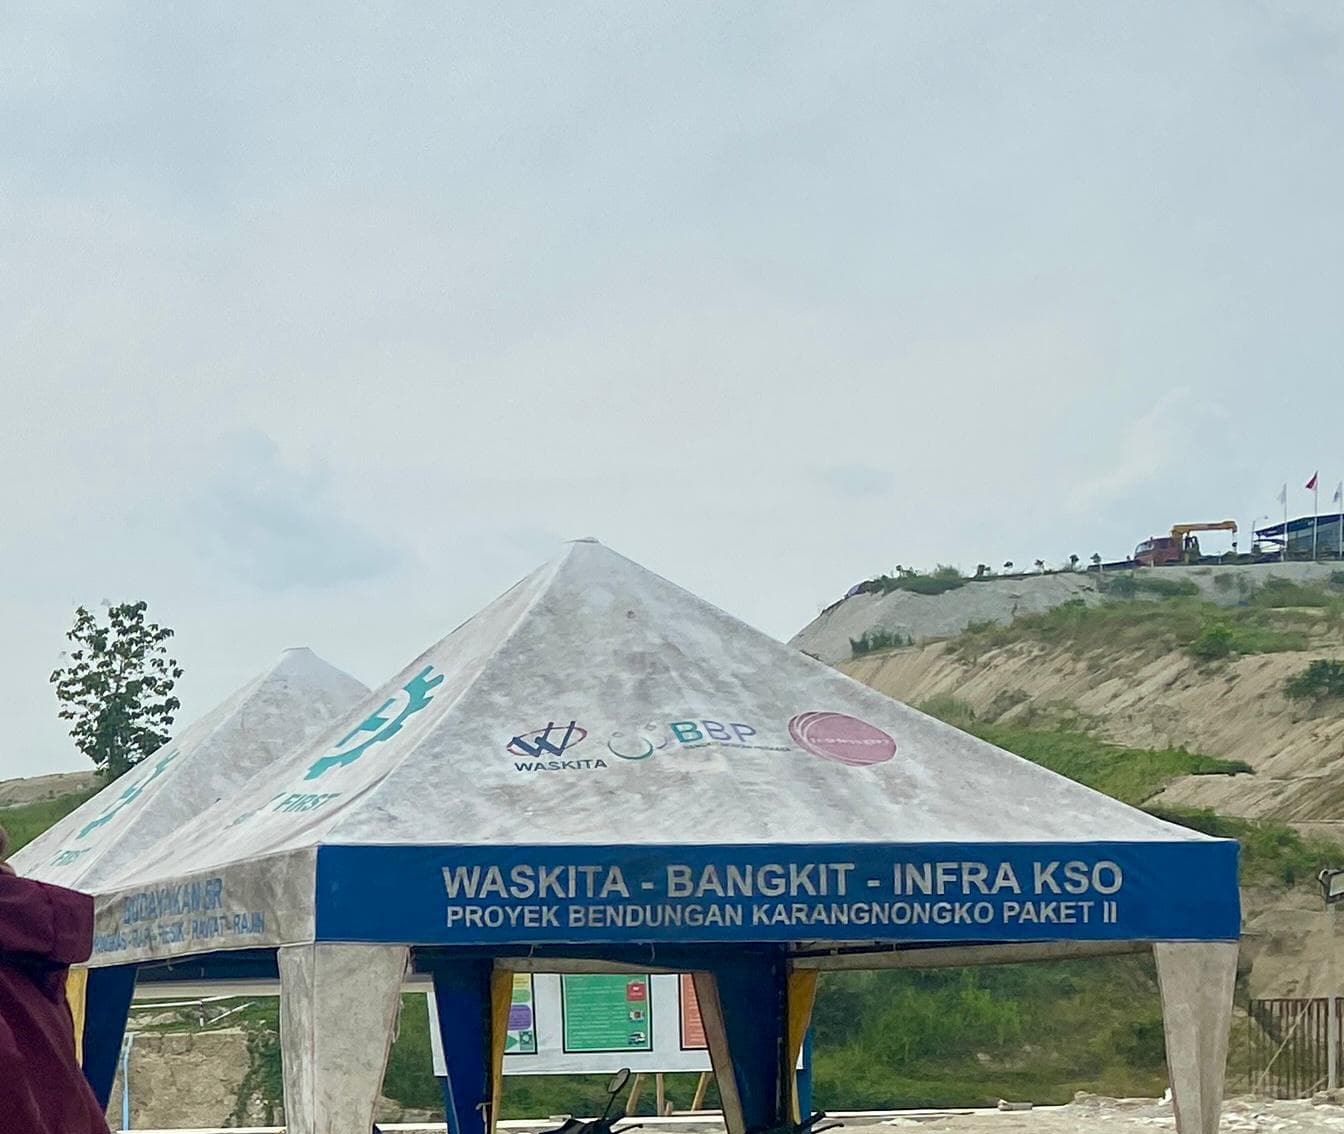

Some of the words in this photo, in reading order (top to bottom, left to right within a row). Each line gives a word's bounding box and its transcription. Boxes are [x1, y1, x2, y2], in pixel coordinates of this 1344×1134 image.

[670, 720, 757, 744] BBP
[514, 759, 608, 772] WASKITA
[442, 864, 630, 898] WASKITA
[641, 882, 655, 891] -
[667, 863, 855, 898] BANGKIT
[867, 879, 881, 887] -
[893, 861, 1021, 895] INFRA
[1033, 860, 1124, 895] KSO
[447, 904, 561, 928] PROYEK
[568, 903, 743, 928] BENDUNGAN
[752, 902, 994, 926] KARANGNONGKO
[1003, 901, 1094, 924] PAKET
[1103, 900, 1117, 924] II
